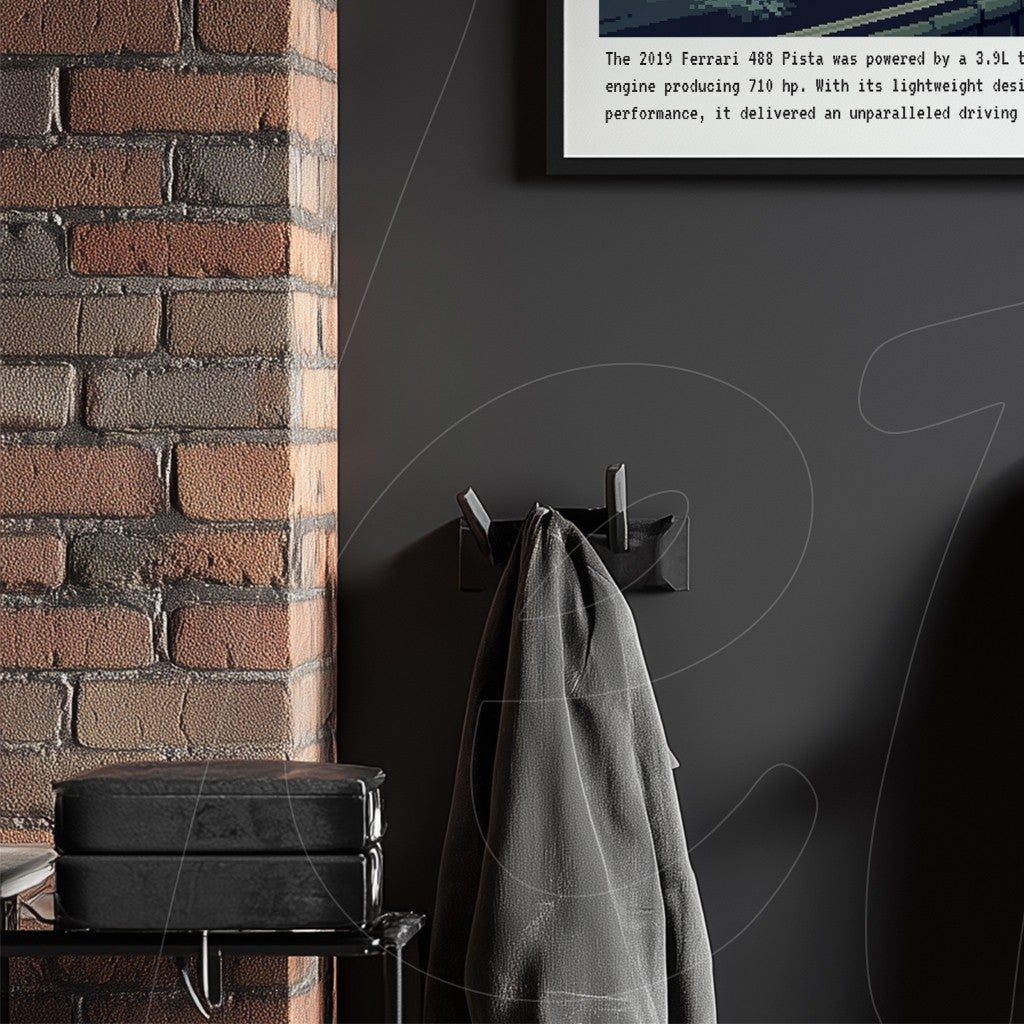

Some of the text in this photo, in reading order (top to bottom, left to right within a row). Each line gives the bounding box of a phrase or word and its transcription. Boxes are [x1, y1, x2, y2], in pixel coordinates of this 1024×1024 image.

[606, 52, 630, 65] The
[640, 52, 672, 65] 2019
[683, 52, 738, 65] Ferrari
[749, 52, 772, 65] 488
[783, 51, 823, 65] Pista
[833, 55, 857, 65] was
[867, 51, 924, 68] powered
[934, 51, 949, 68] by
[959, 55, 966, 65] a
[976, 51, 1009, 65] 3.9L
[606, 79, 655, 96] engine
[665, 79, 739, 96] producing
[749, 79, 772, 92] 710
[783, 79, 804, 96] hp.
[816, 79, 849, 92] With
[859, 79, 882, 92] its
[893, 79, 982, 96] lightweight
[606, 107, 703, 123] performance,
[716, 107, 730, 119] it
[740, 107, 815, 119] delivered
[825, 110, 840, 119] an
[850, 106, 950, 123] unparalleled
[959, 106, 1017, 122] driving
